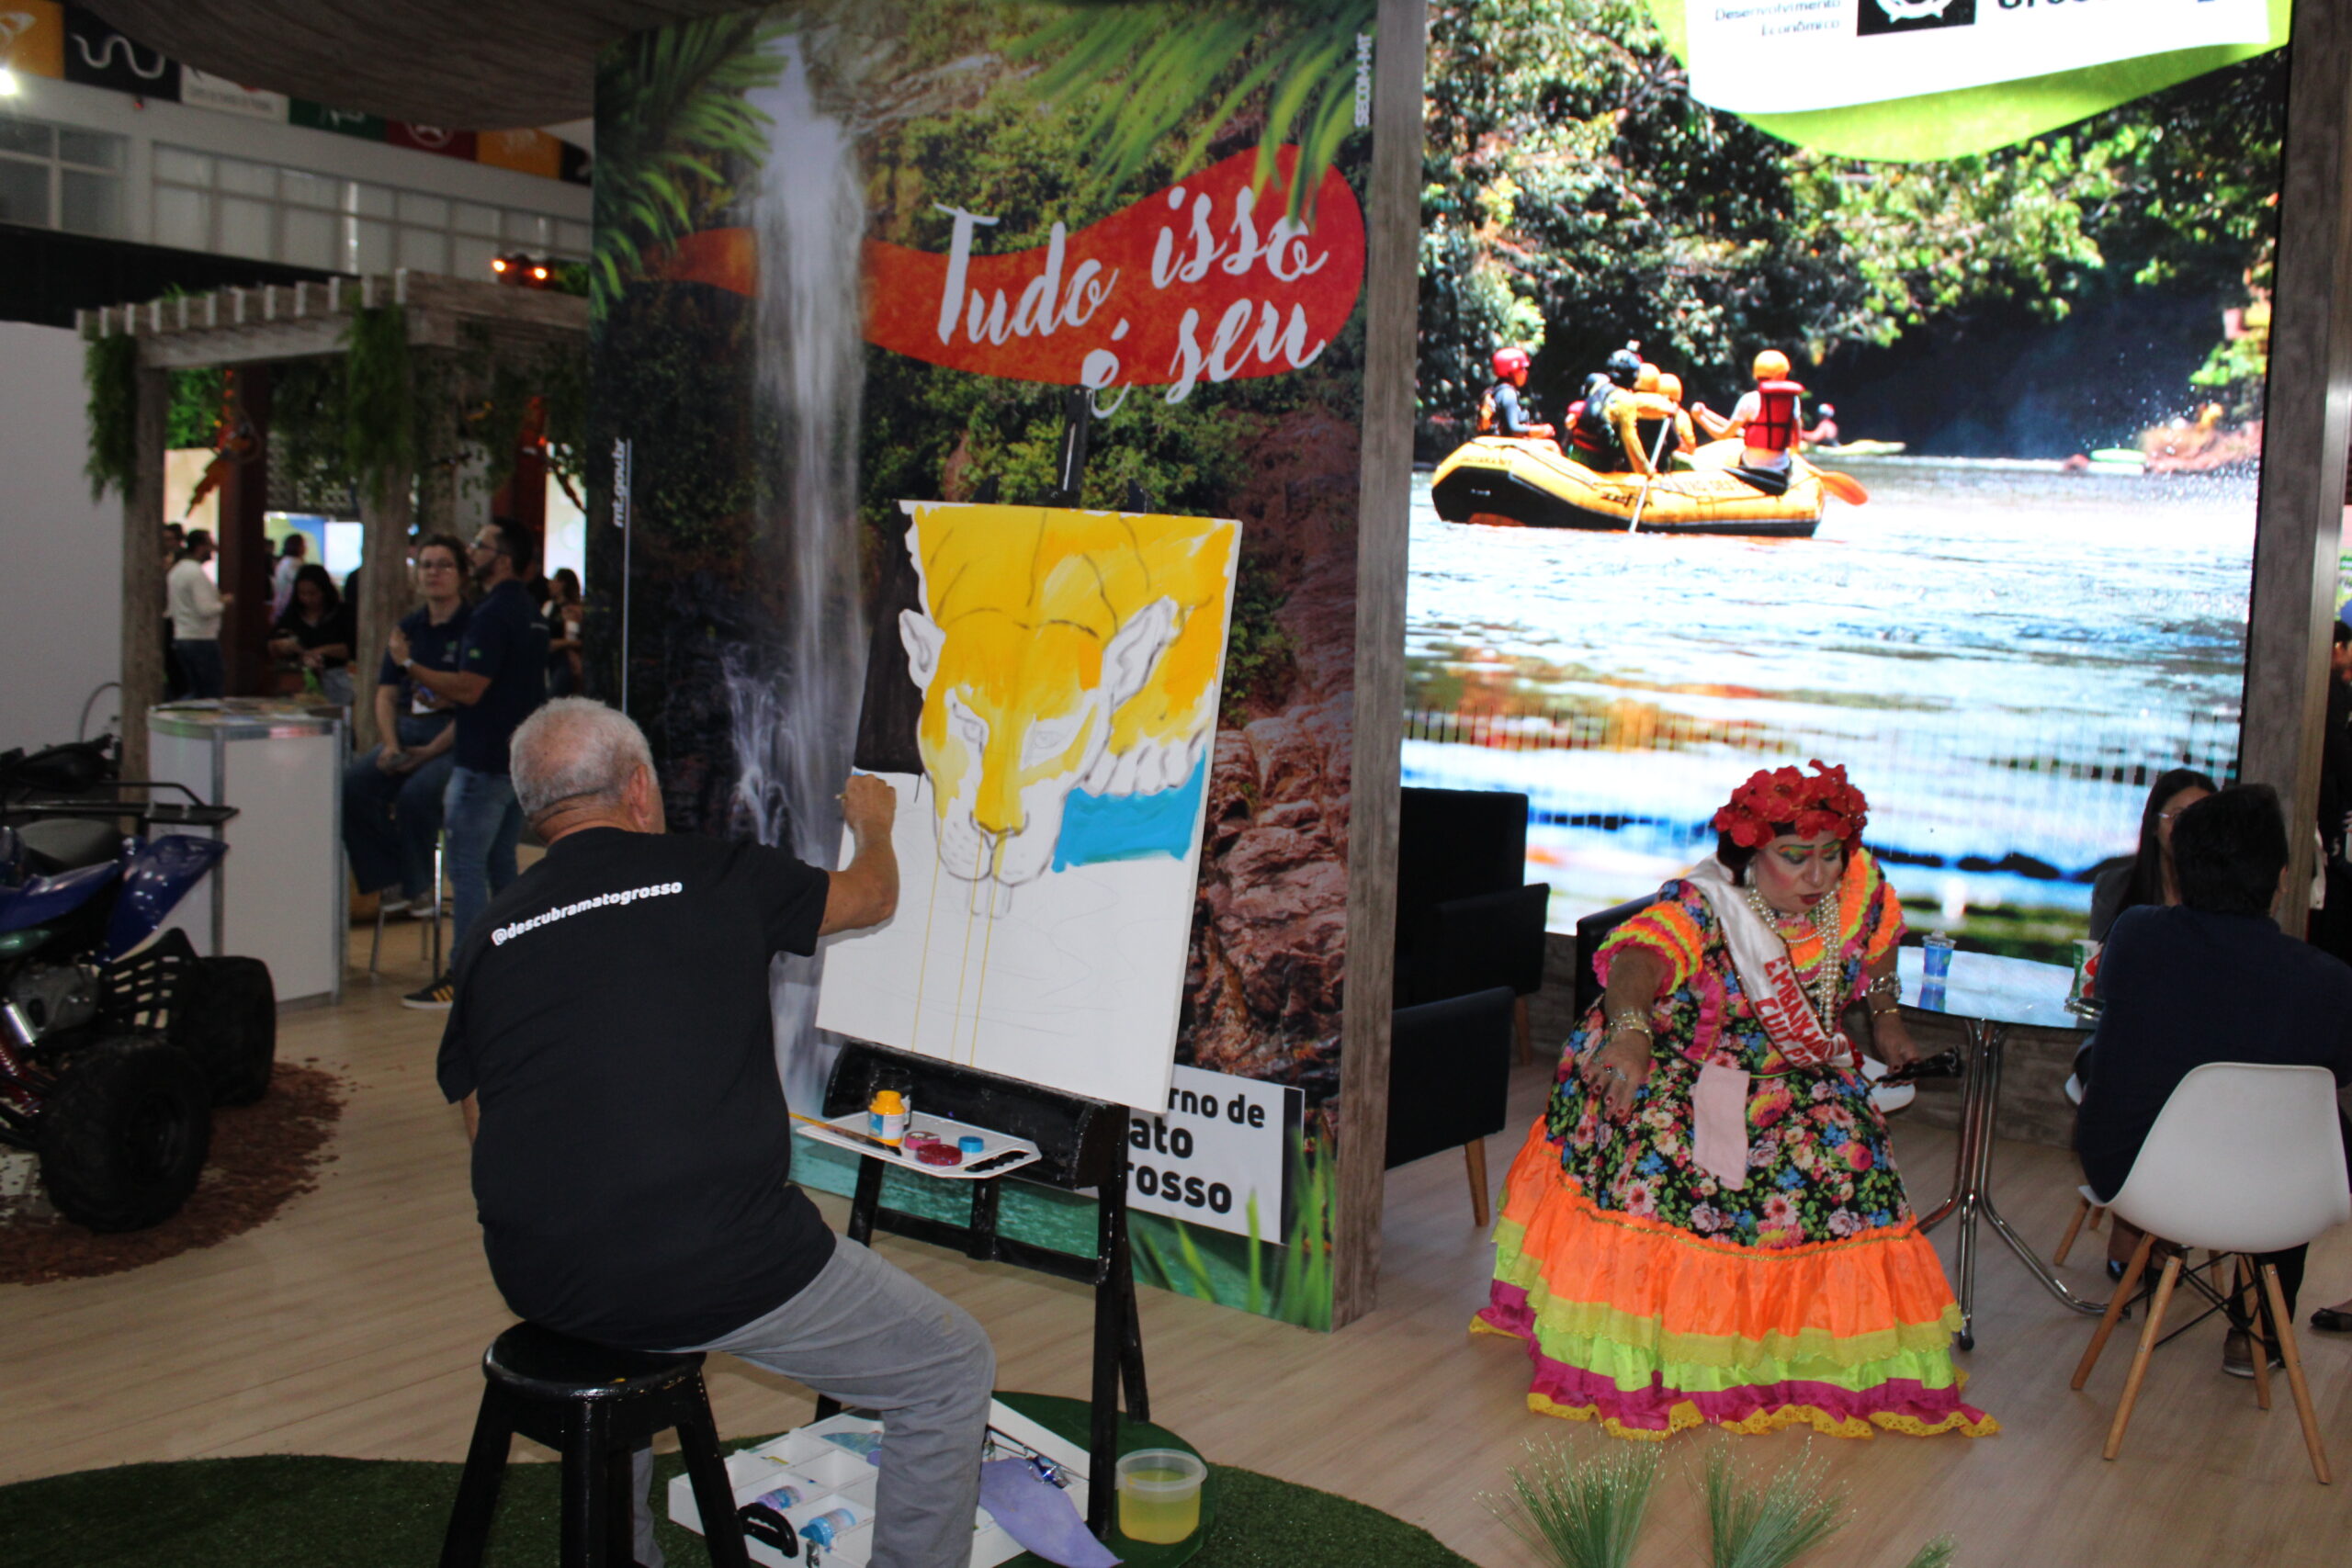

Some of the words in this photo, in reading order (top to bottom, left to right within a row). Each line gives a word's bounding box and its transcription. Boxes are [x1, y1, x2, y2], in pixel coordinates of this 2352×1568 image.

[1355, 33, 1372, 127] SECOM-MT
[934, 202, 1119, 345] Tudo
[1151, 186, 1329, 289] isso
[1165, 299, 1325, 405] seu
[492, 882, 683, 946] @descubramatogrosso
[1129, 1115, 1193, 1158] ato
[1168, 1088, 1218, 1118] rno
[1227, 1094, 1265, 1128] de
[1127, 1162, 1232, 1213] osso
